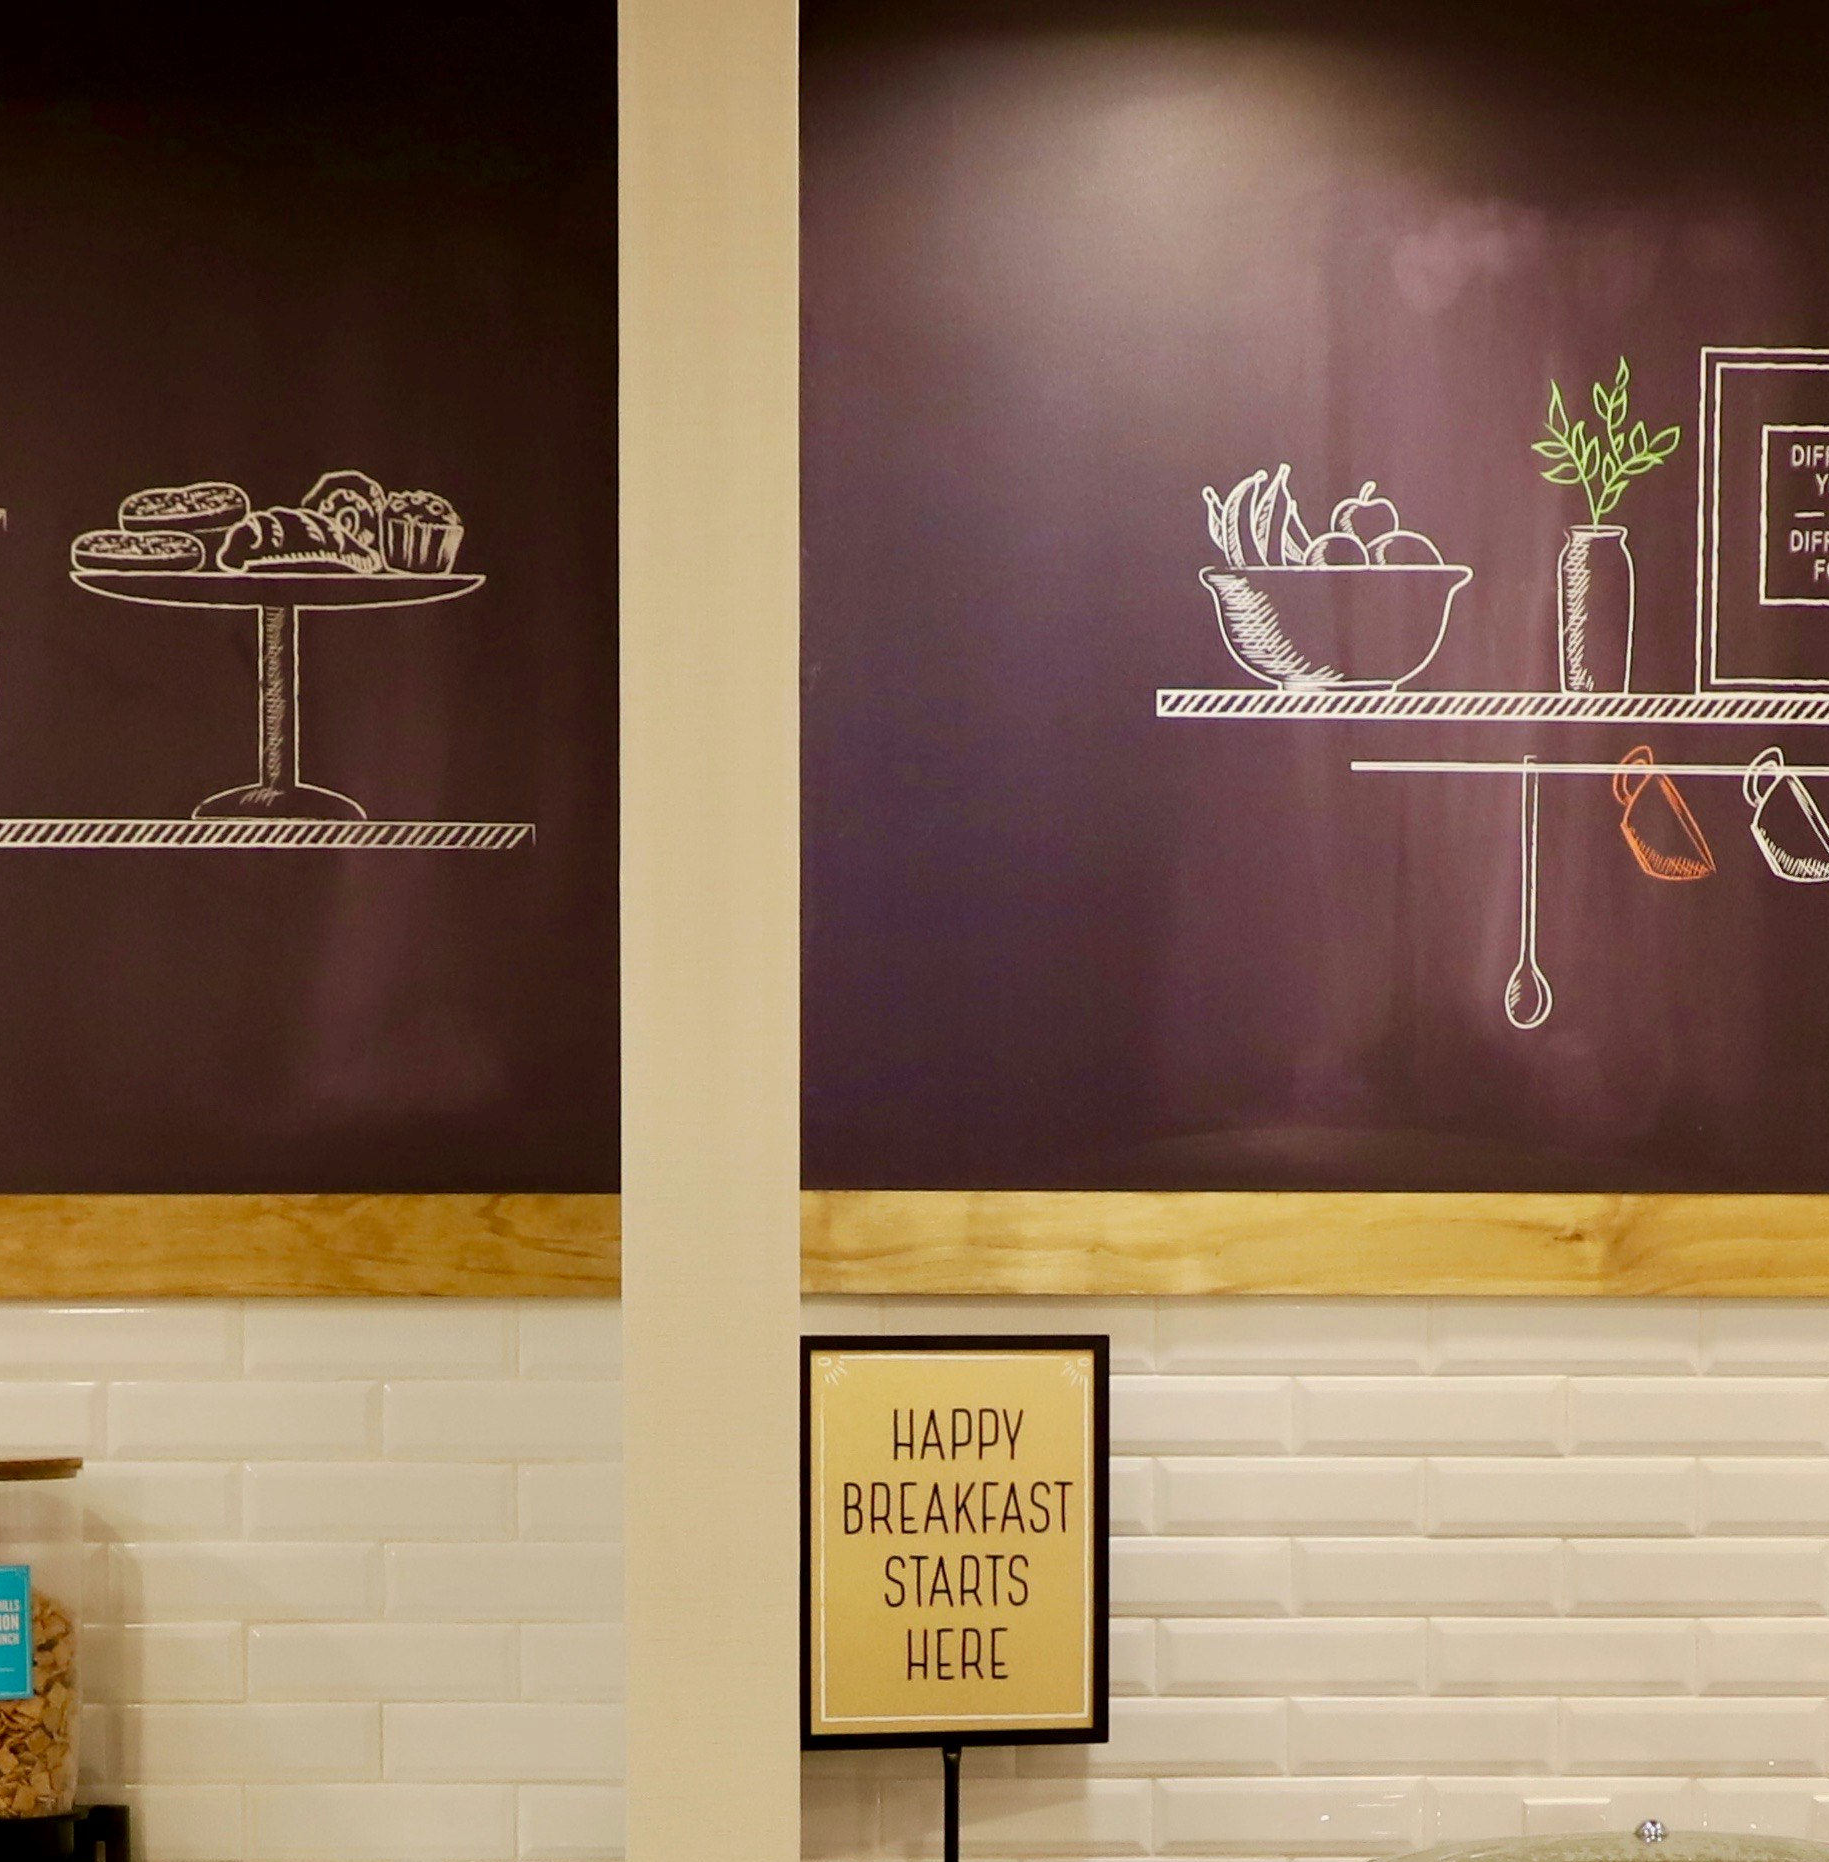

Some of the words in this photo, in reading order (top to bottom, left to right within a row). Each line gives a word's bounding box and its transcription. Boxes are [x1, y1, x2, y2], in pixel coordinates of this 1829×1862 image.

[892, 1408, 1024, 1461] HAPPY
[842, 1481, 1074, 1535] BREAKFAST
[883, 1554, 1030, 1608] STARTS
[906, 1626, 1010, 1681] HERE
